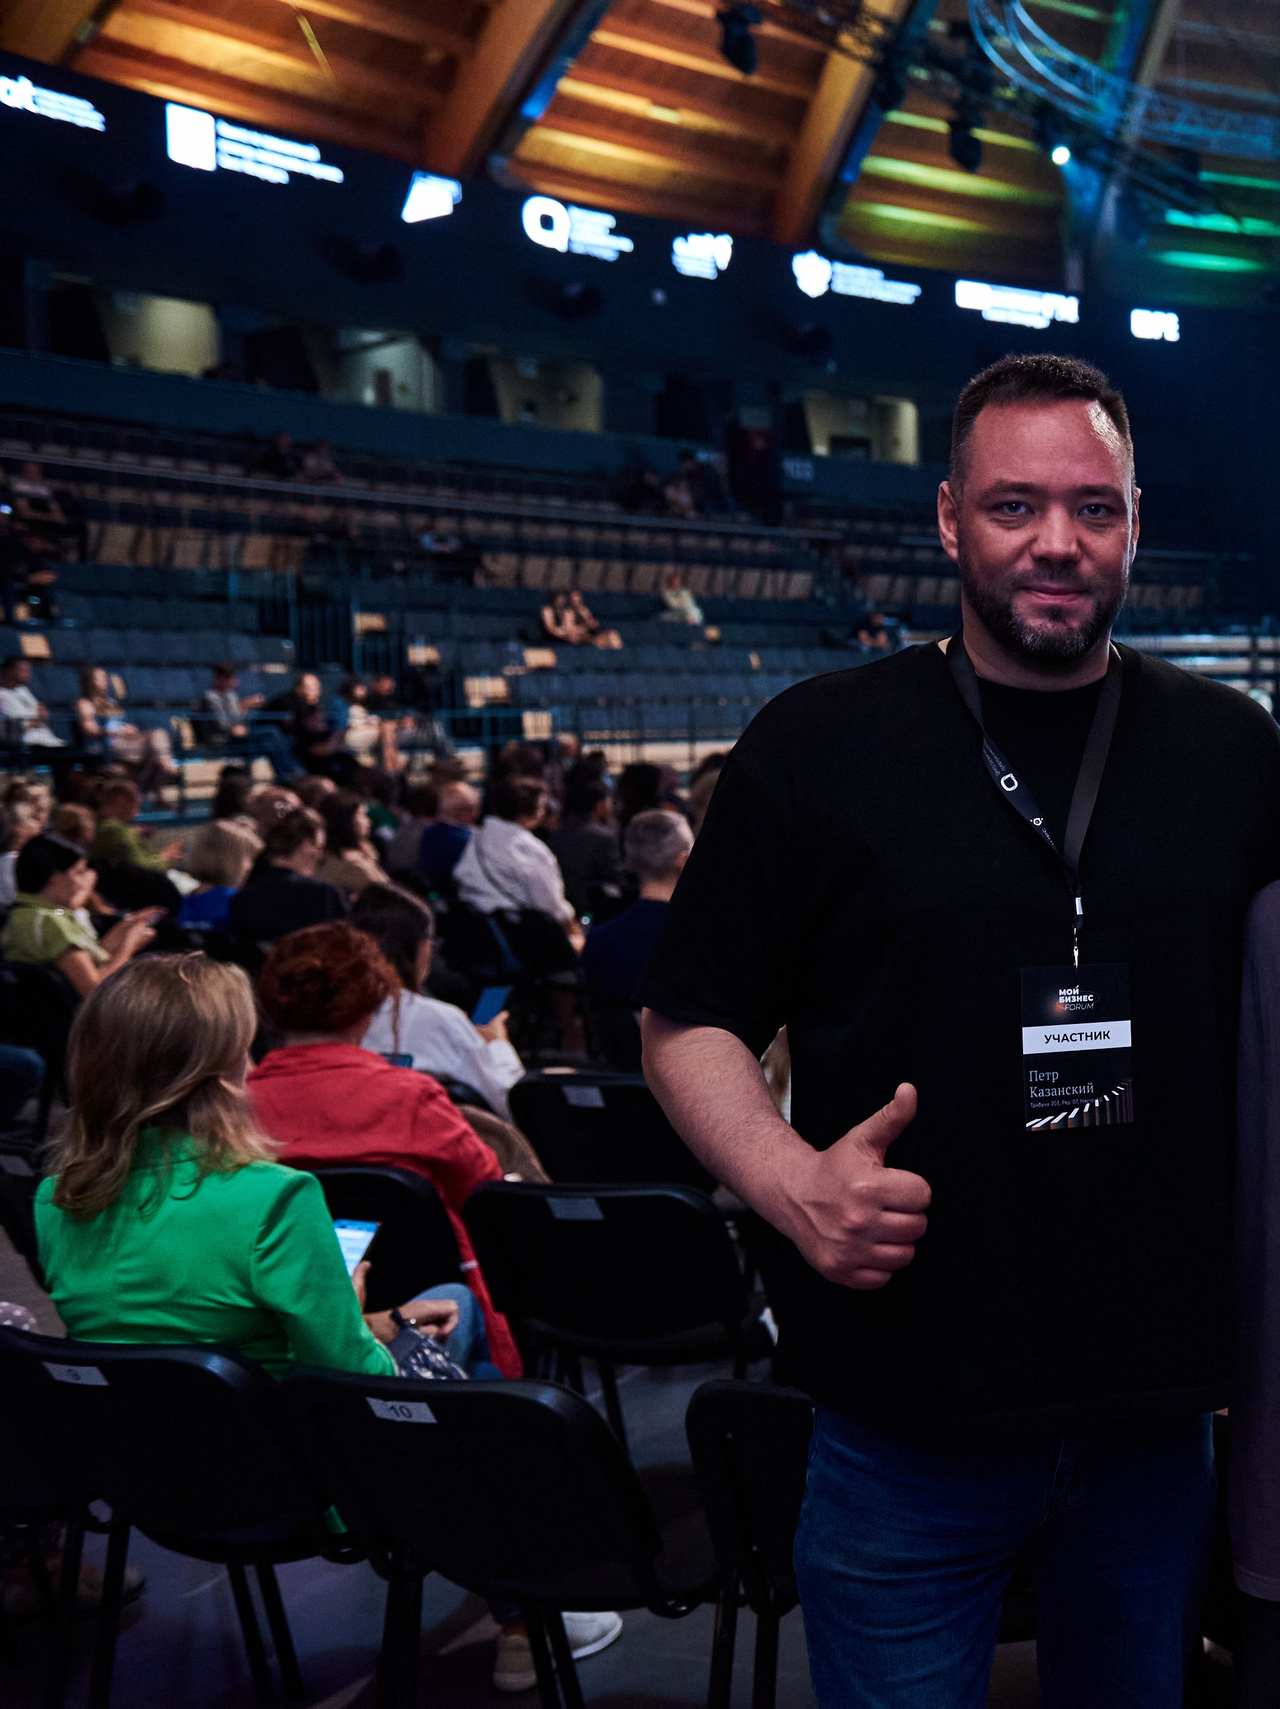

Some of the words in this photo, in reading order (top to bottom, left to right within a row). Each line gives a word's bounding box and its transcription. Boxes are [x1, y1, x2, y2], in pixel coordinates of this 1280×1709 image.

[1058, 985, 1079, 996] МОЙ
[1058, 994, 1094, 1003] БИЗНЕС
[1064, 1002, 1094, 1011] FORUM
[1044, 1030, 1110, 1044] УЧАСТНИК
[1028, 1069, 1059, 1083] Петр
[1028, 1081, 1094, 1098] Казанский
[388, 1405, 412, 1419] 10
